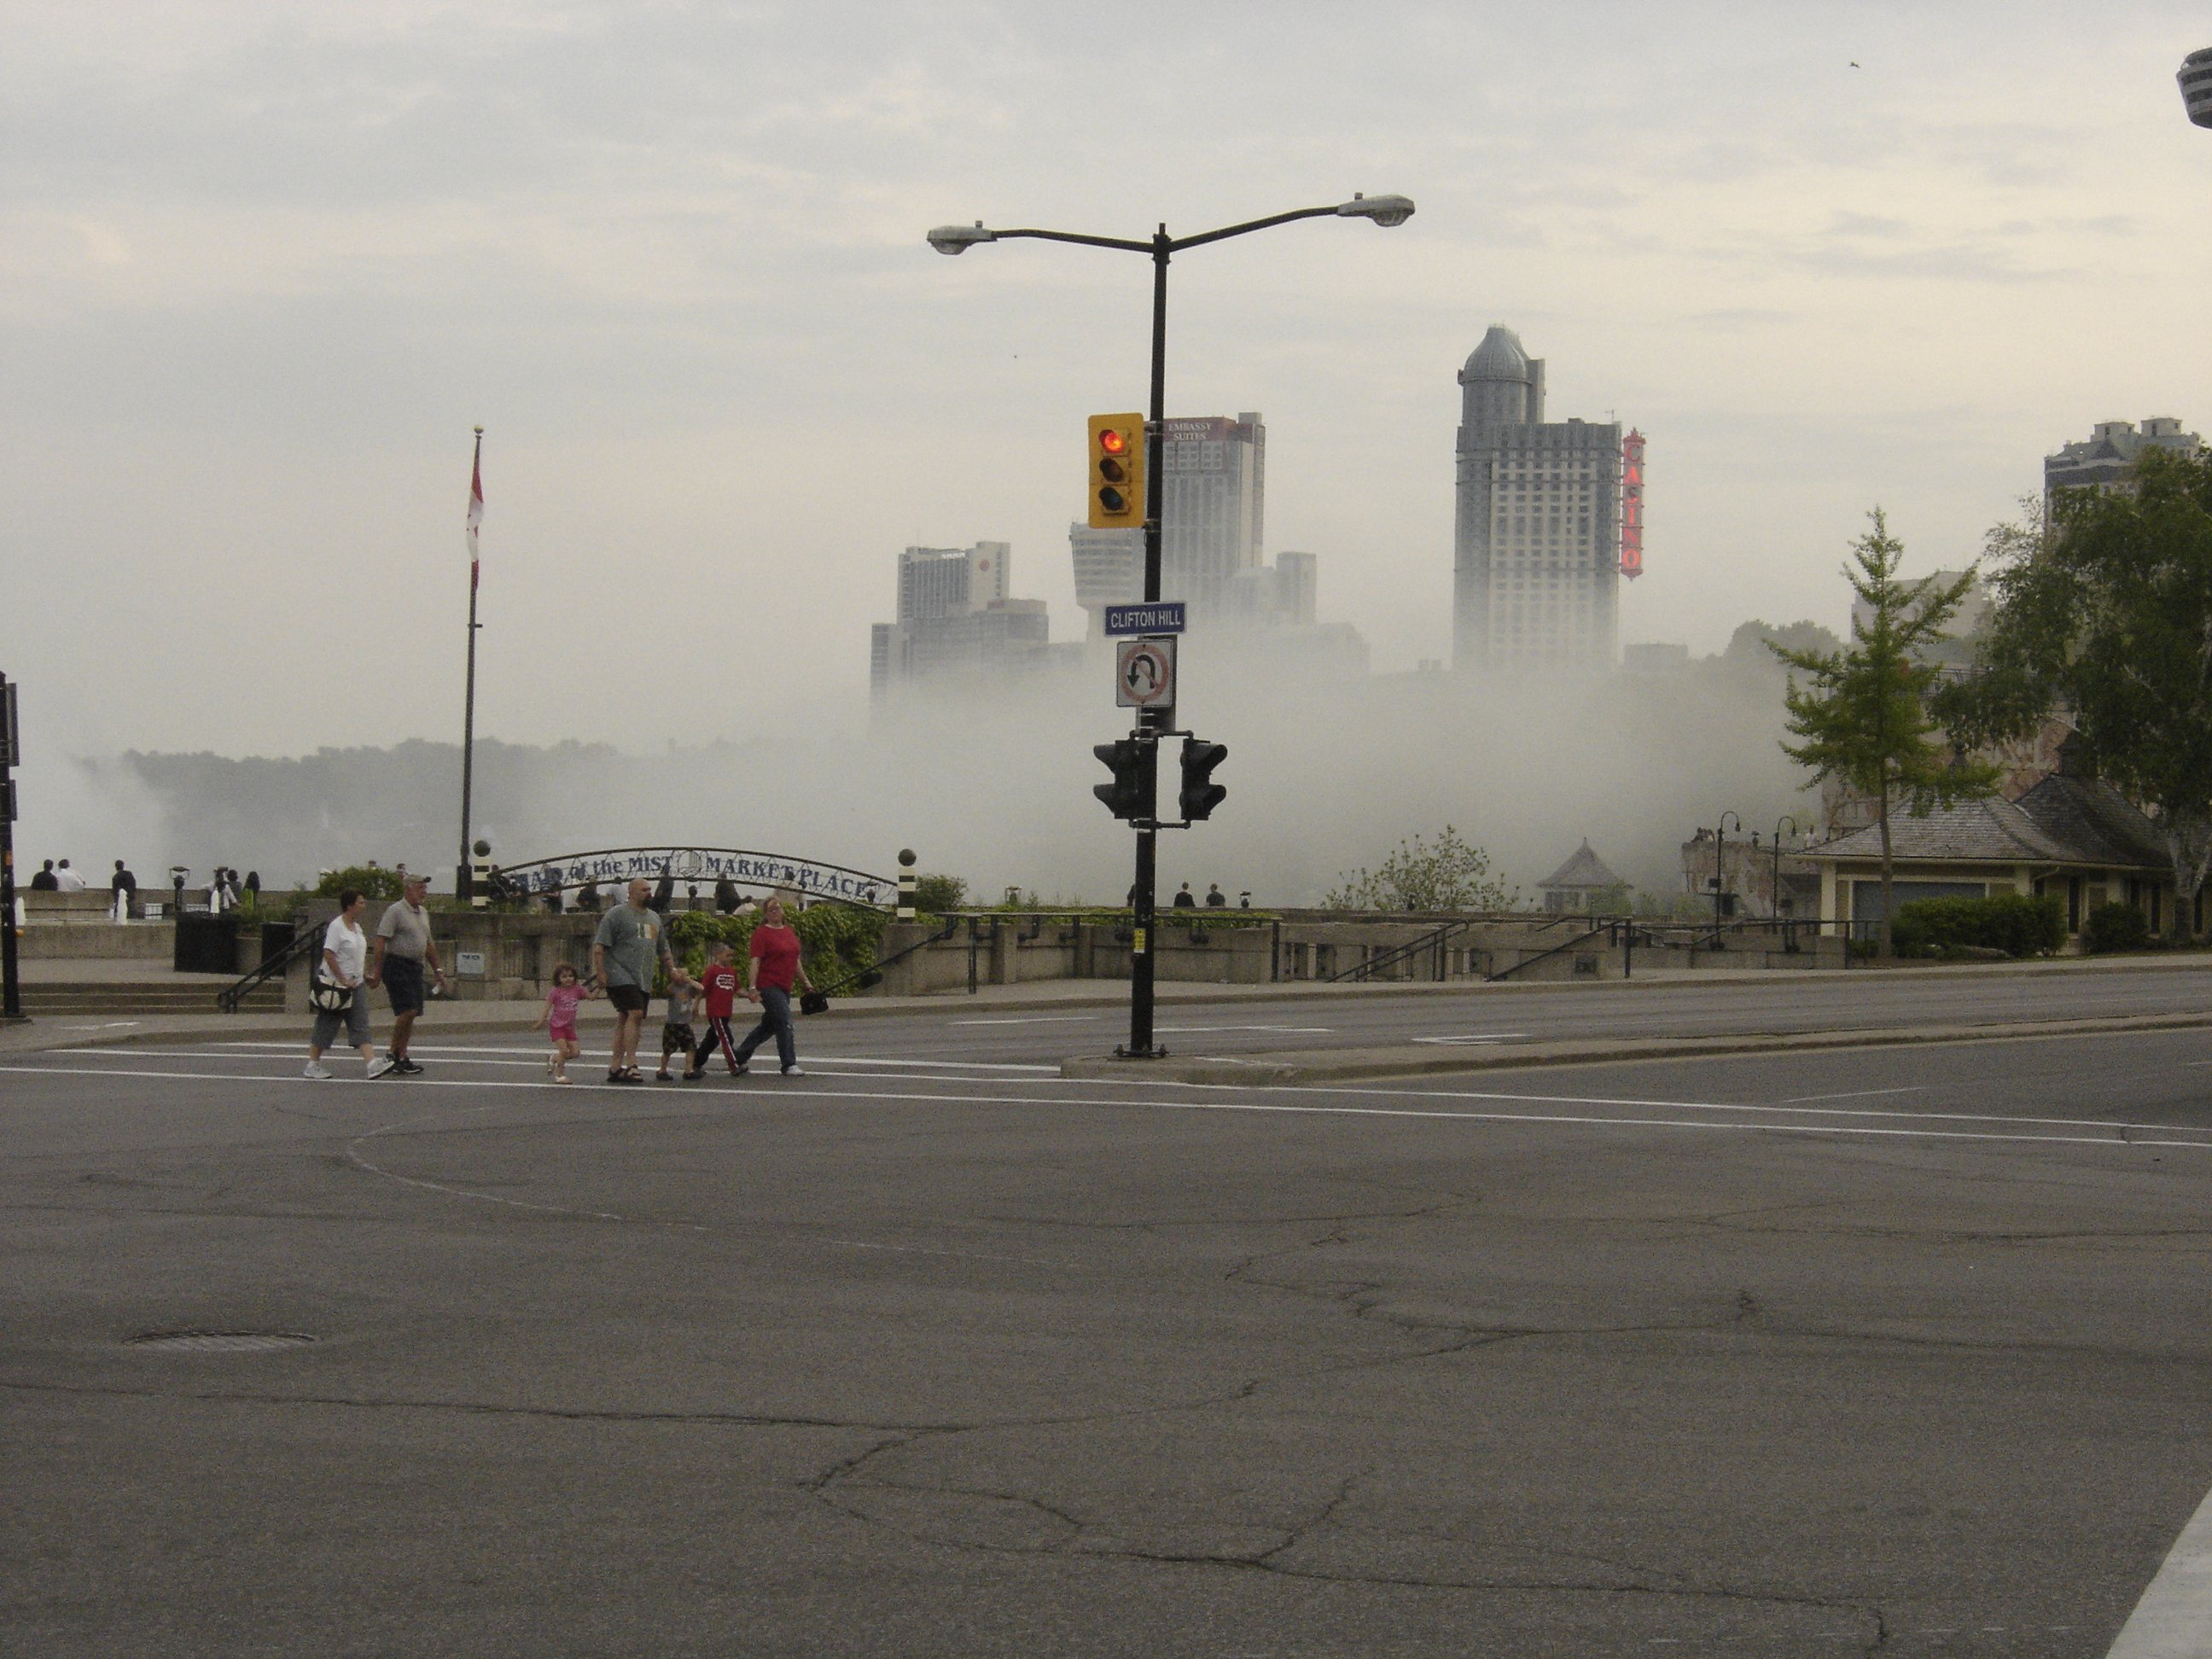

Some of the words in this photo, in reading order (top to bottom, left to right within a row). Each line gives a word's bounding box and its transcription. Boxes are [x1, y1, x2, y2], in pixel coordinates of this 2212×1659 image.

[1168, 422, 1212, 431] EMBASSY
[1173, 432, 1207, 440] SUITES
[1622, 444, 1641, 568] CASINO
[1110, 611, 1155, 629] CLIFTON
[1158, 609, 1181, 626] HILL
[593, 859, 623, 876] the
[628, 856, 674, 876] MIST
[706, 856, 795, 882] MARKET
[800, 869, 868, 897] PLACE
